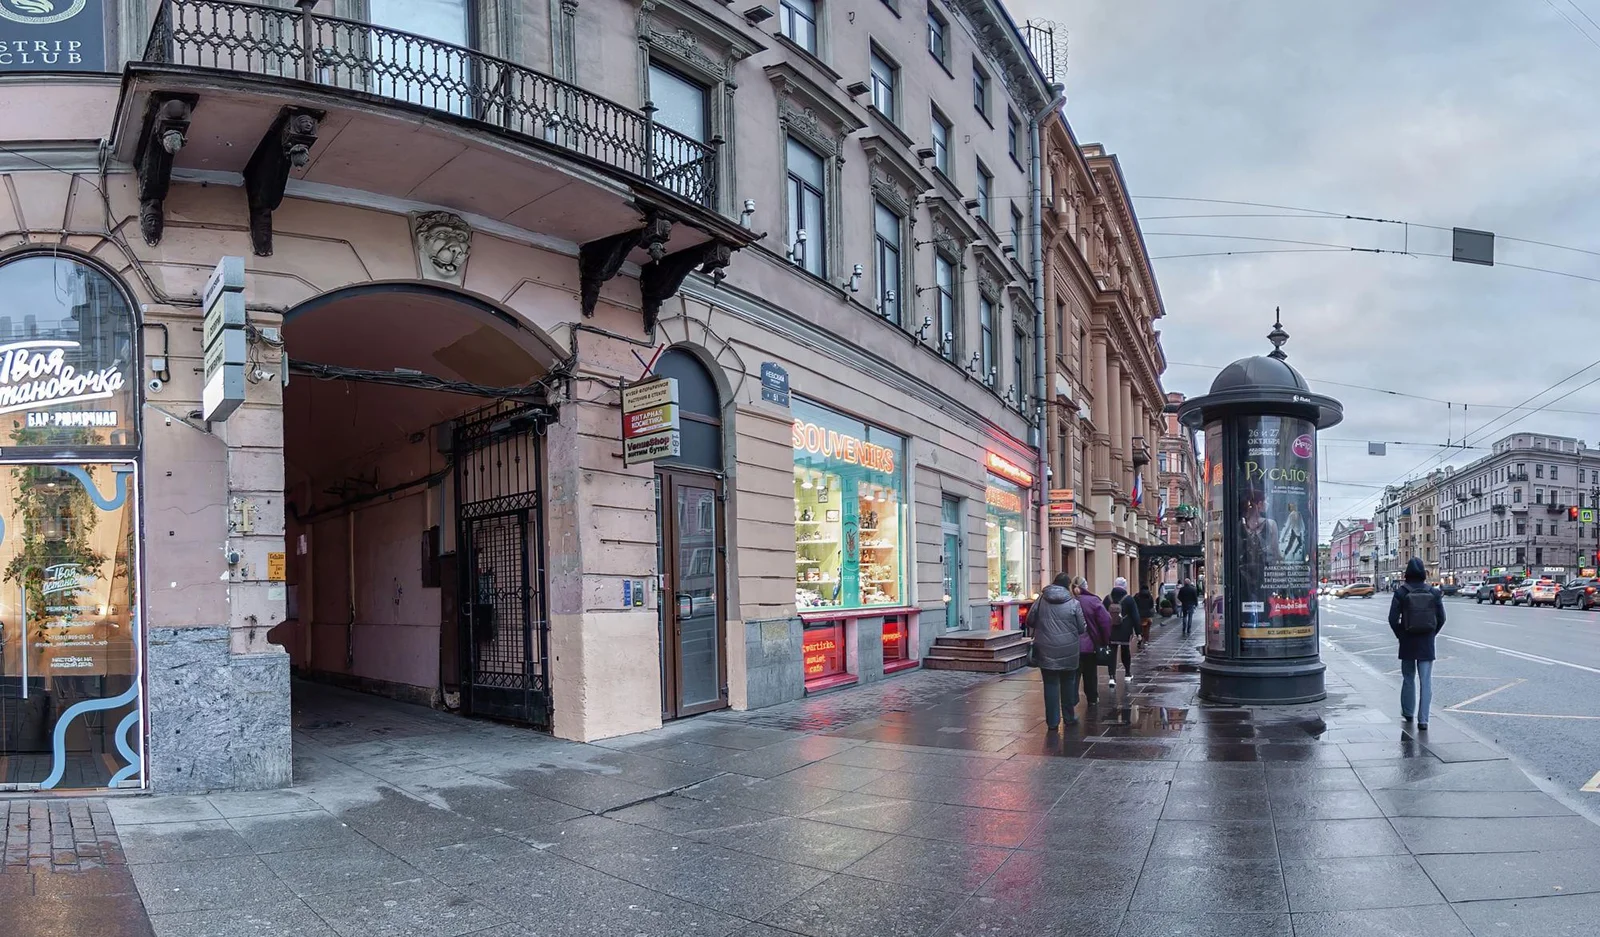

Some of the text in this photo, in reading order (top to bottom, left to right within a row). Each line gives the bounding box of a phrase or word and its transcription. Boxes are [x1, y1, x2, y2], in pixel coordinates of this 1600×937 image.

[0, 40, 82, 52] STRIP
[0, 53, 82, 64] CLUB
[772, 393, 779, 402] 51
[631, 409, 663, 422] ЯНТАРНАЯ
[631, 416, 663, 428] КОСМЕТИКА
[1248, 429, 1259, 437] 26
[1270, 429, 1280, 437] 27
[649, 446, 670, 455] бутик
[792, 418, 894, 475] SOUVENIRS
[45, 563, 82, 580] Твоя
[809, 664, 824, 673] cafe
